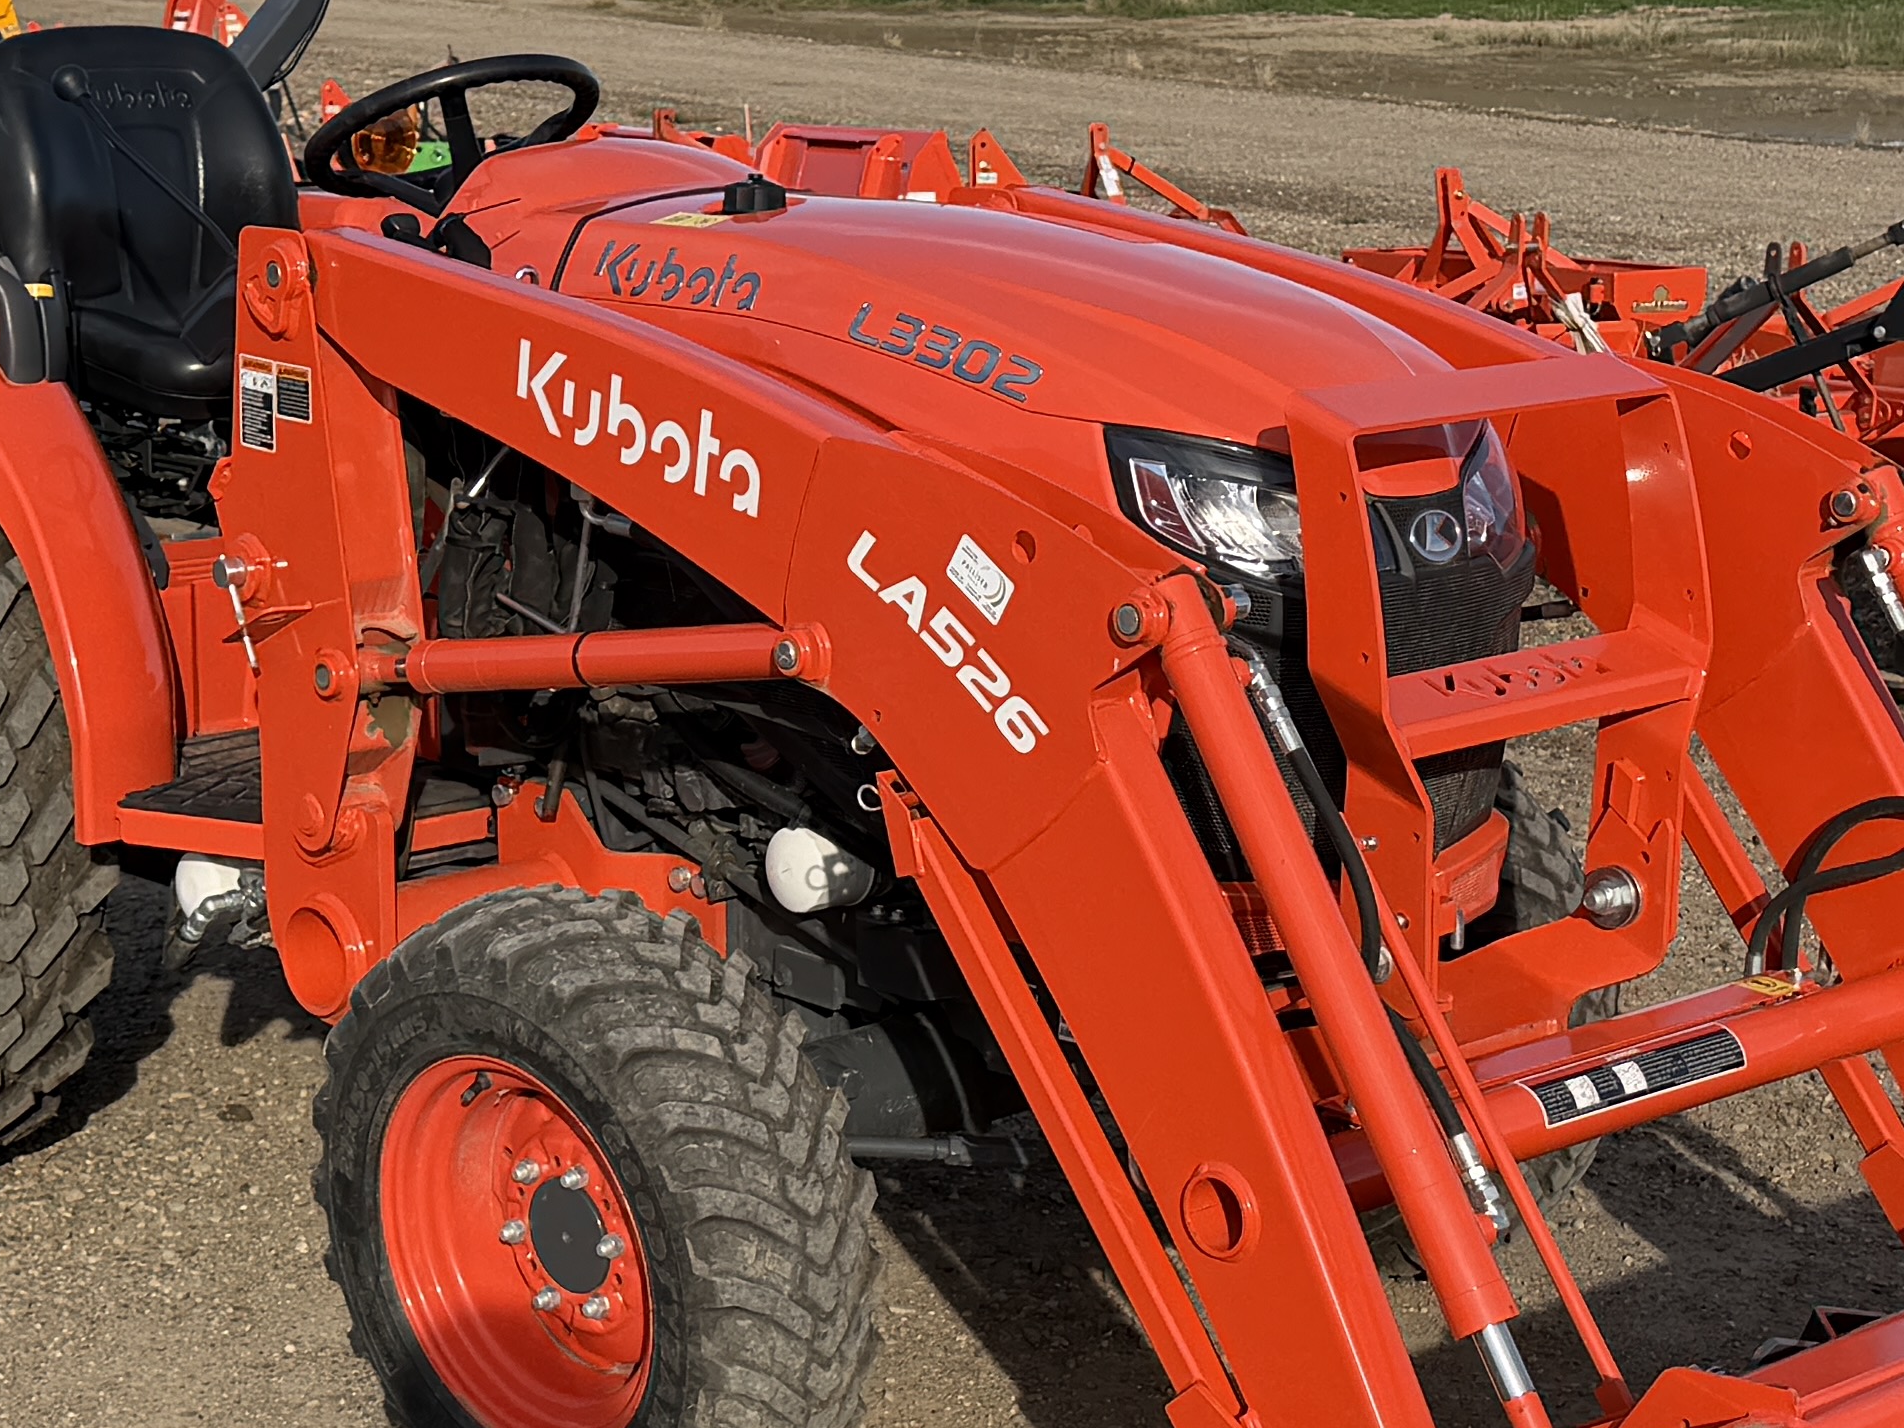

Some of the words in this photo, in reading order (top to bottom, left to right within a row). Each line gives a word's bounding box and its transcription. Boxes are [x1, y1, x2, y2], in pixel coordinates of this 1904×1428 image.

[594, 239, 761, 311] Kubota
[847, 302, 1044, 403] L3302
[516, 338, 761, 519] Kubota
[846, 529, 1050, 755] LA526
[1421, 652, 1612, 700] Kubota
